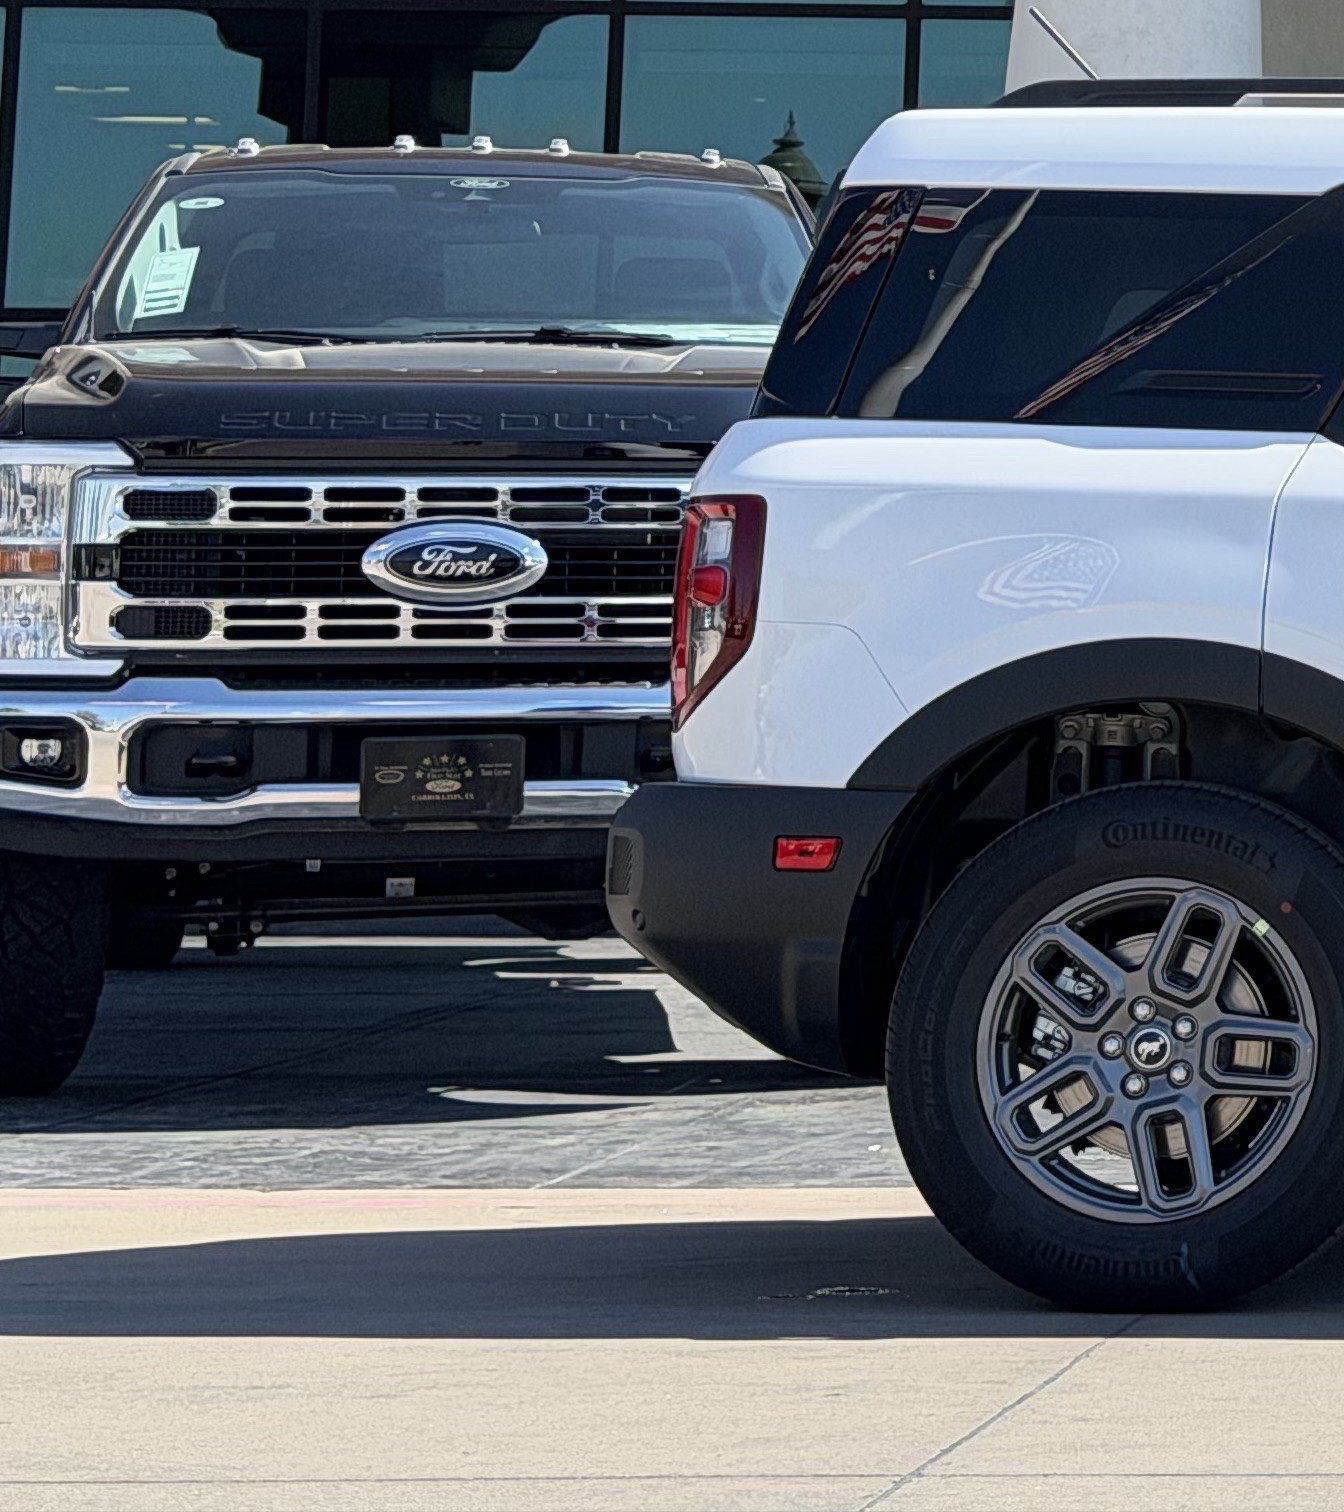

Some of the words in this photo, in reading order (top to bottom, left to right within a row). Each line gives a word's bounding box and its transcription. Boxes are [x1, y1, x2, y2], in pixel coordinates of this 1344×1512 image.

[219, 411, 483, 432] SUPER
[499, 411, 697, 433] DUTY
[412, 544, 498, 577] Ford
